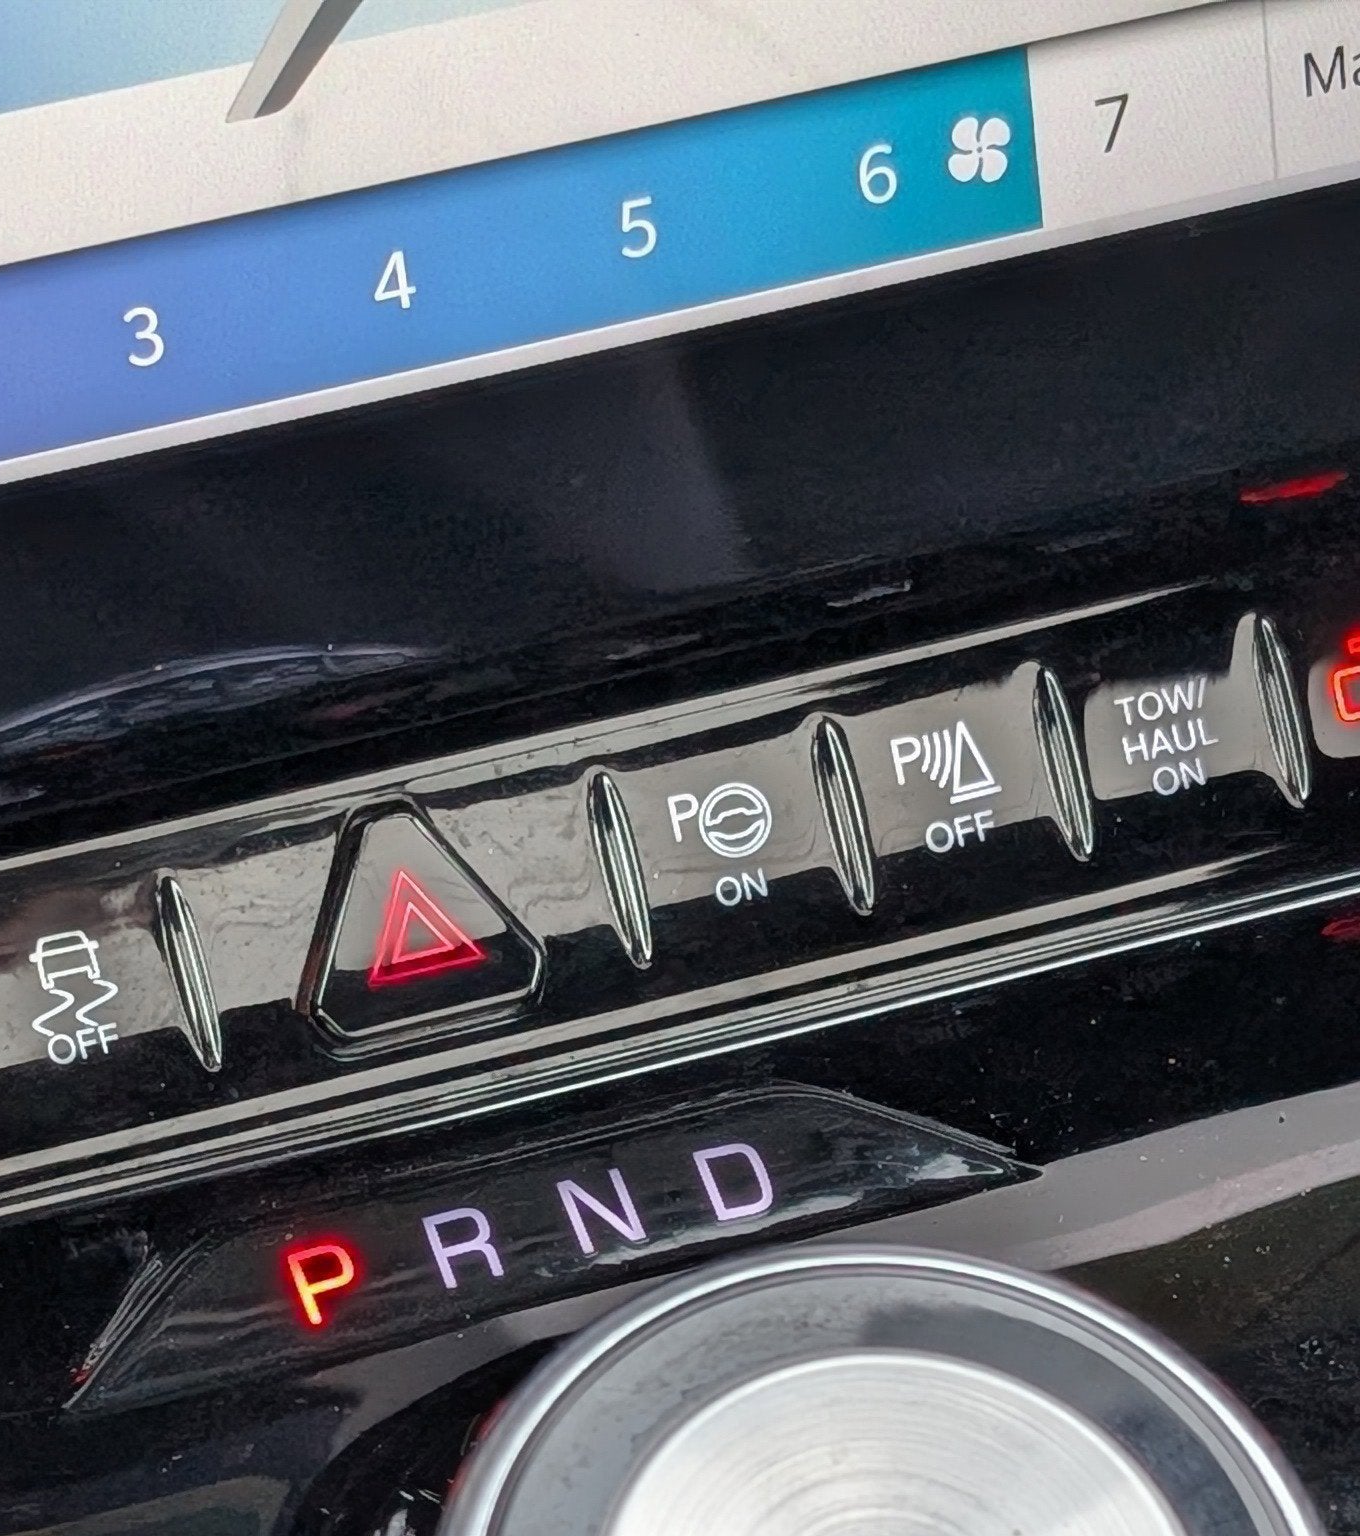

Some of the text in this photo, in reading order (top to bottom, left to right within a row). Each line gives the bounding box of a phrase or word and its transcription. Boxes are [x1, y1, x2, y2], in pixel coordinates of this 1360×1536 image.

[1094, 93, 1130, 154] 7
[858, 143, 898, 205] 6
[620, 196, 658, 259] 5
[374, 251, 416, 310] 4
[123, 307, 165, 368] 3
[1114, 677, 1207, 729] TOW/
[1122, 716, 1218, 767] HAUL
[1153, 757, 1207, 797] ON
[925, 811, 996, 854] OFF
[716, 867, 768, 907] ON
[47, 1023, 120, 1065] OFF
[288, 1142, 774, 1326] P R N D
